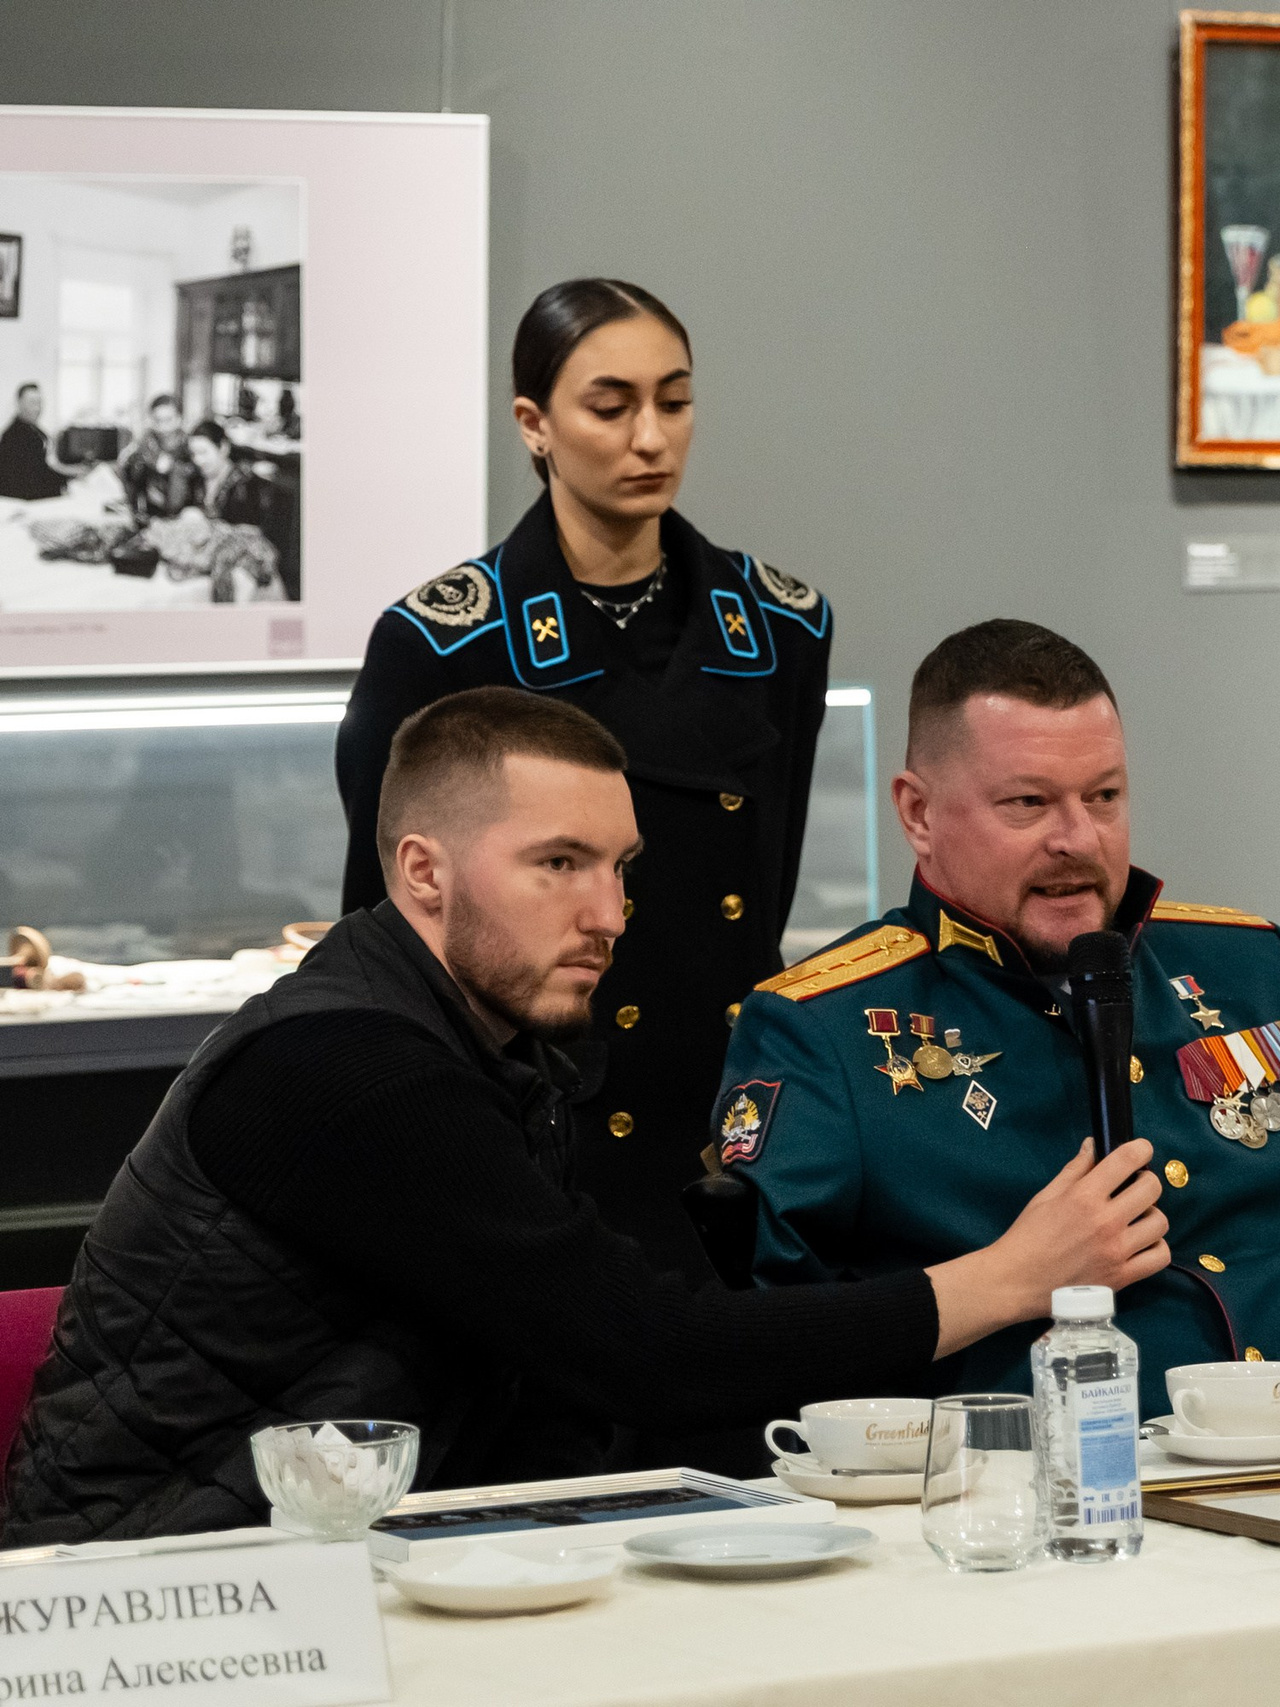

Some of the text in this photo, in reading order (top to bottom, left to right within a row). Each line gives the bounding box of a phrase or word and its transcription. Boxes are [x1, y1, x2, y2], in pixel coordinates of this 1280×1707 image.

[865, 1419, 930, 1441] Greenfield
[0, 1580, 279, 1636] ЖУРАВЛЕВА
[101, 1646, 328, 1692] Алексеевна
